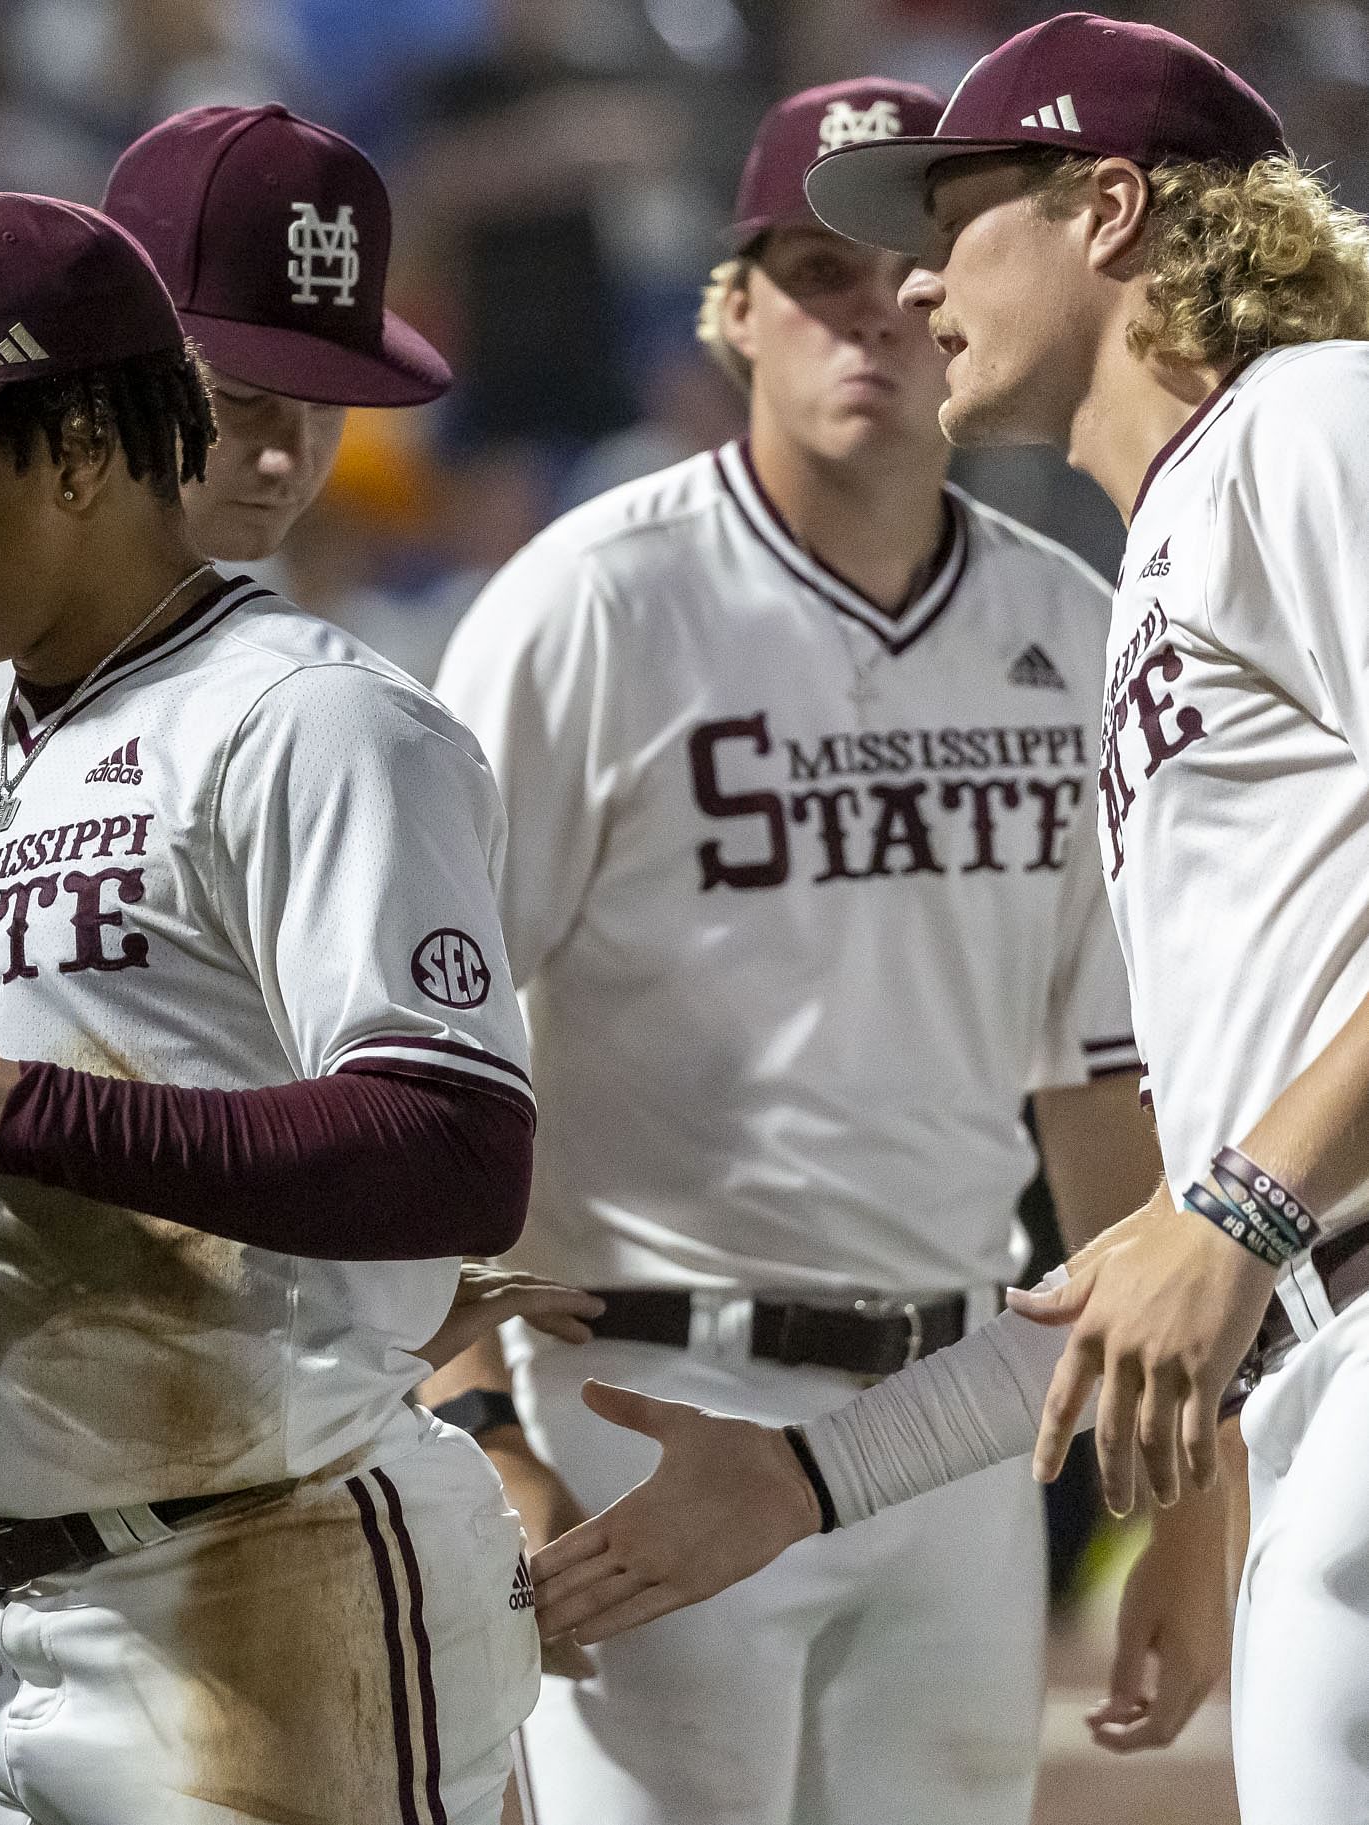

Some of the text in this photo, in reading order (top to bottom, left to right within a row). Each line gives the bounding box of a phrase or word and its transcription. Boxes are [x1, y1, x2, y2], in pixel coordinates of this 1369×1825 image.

[85, 762, 143, 786] adidas
[786, 725, 1085, 782] MISSISSIPPI
[687, 712, 1084, 891] STATE
[419, 934, 486, 1002] SEC
